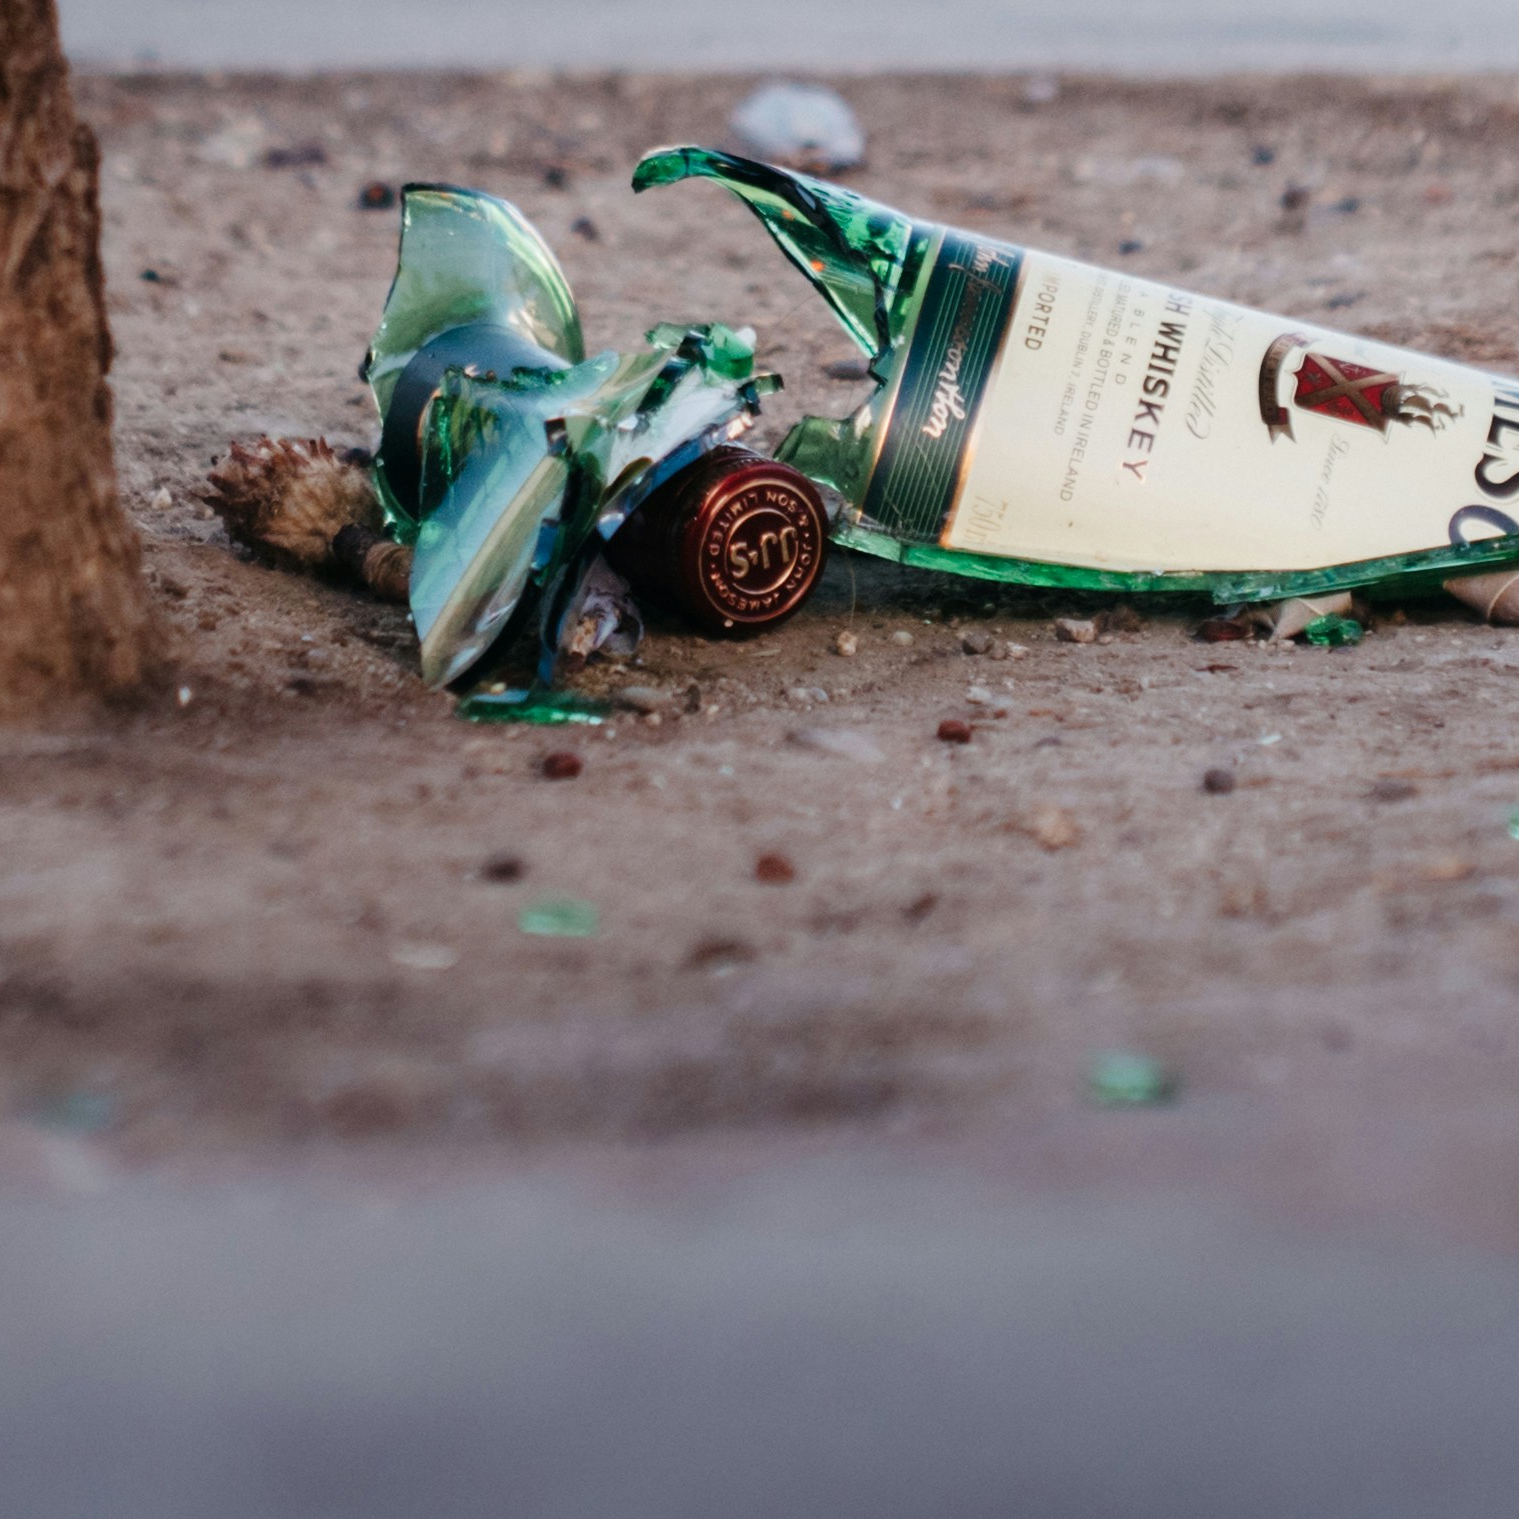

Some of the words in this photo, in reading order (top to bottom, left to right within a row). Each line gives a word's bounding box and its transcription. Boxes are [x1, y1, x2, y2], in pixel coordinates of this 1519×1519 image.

[1072, 331, 1094, 369] DUBLIN
[1114, 309, 1145, 385] BLEND
[1053, 382, 1077, 436] IRELAND
[1084, 349, 1115, 411] BOTTLED
[1120, 321, 1187, 484] WHISKEY
[1079, 414, 1094, 429] IN
[1059, 432, 1089, 501] IRELAND
[708, 491, 758, 556] LIMITED
[764, 490, 798, 512] SON
[709, 572, 780, 611] JAMESON
